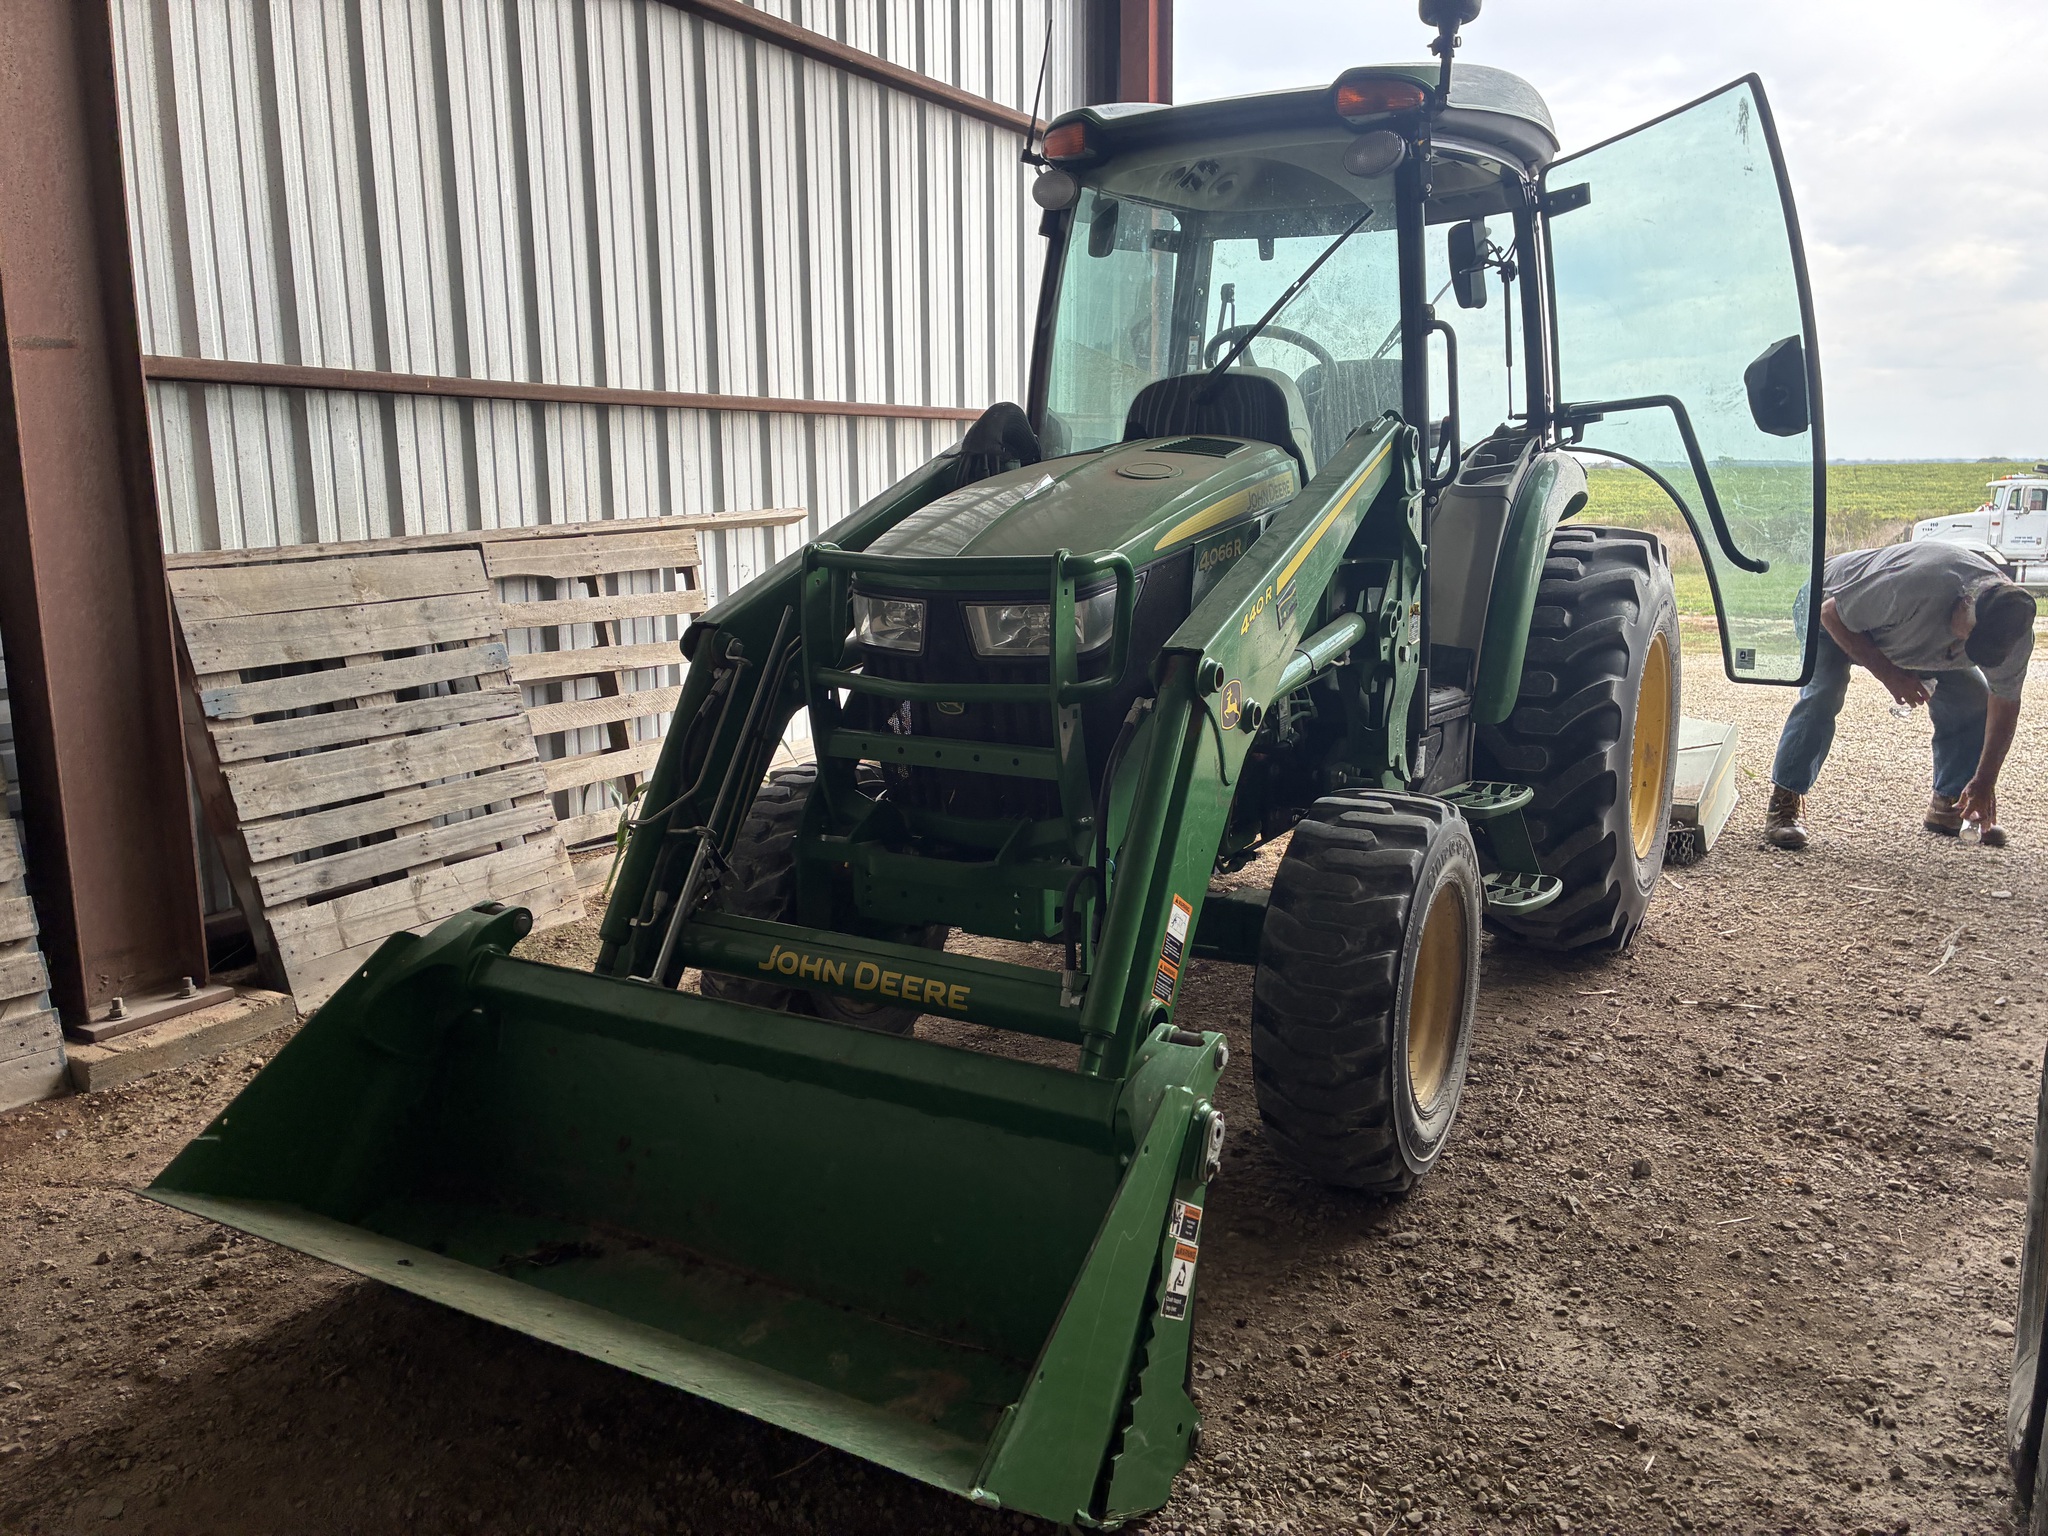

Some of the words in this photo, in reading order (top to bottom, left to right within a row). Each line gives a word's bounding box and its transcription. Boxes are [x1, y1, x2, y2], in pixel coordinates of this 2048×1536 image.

[1247, 487, 1270, 511] JOHN
[1269, 480, 1291, 503] DEERE
[1199, 538, 1242, 571] 4066R
[1240, 595, 1264, 636] 440
[1265, 585, 1272, 605] R
[758, 944, 847, 986] JOHN
[854, 961, 971, 1012] DEERE
